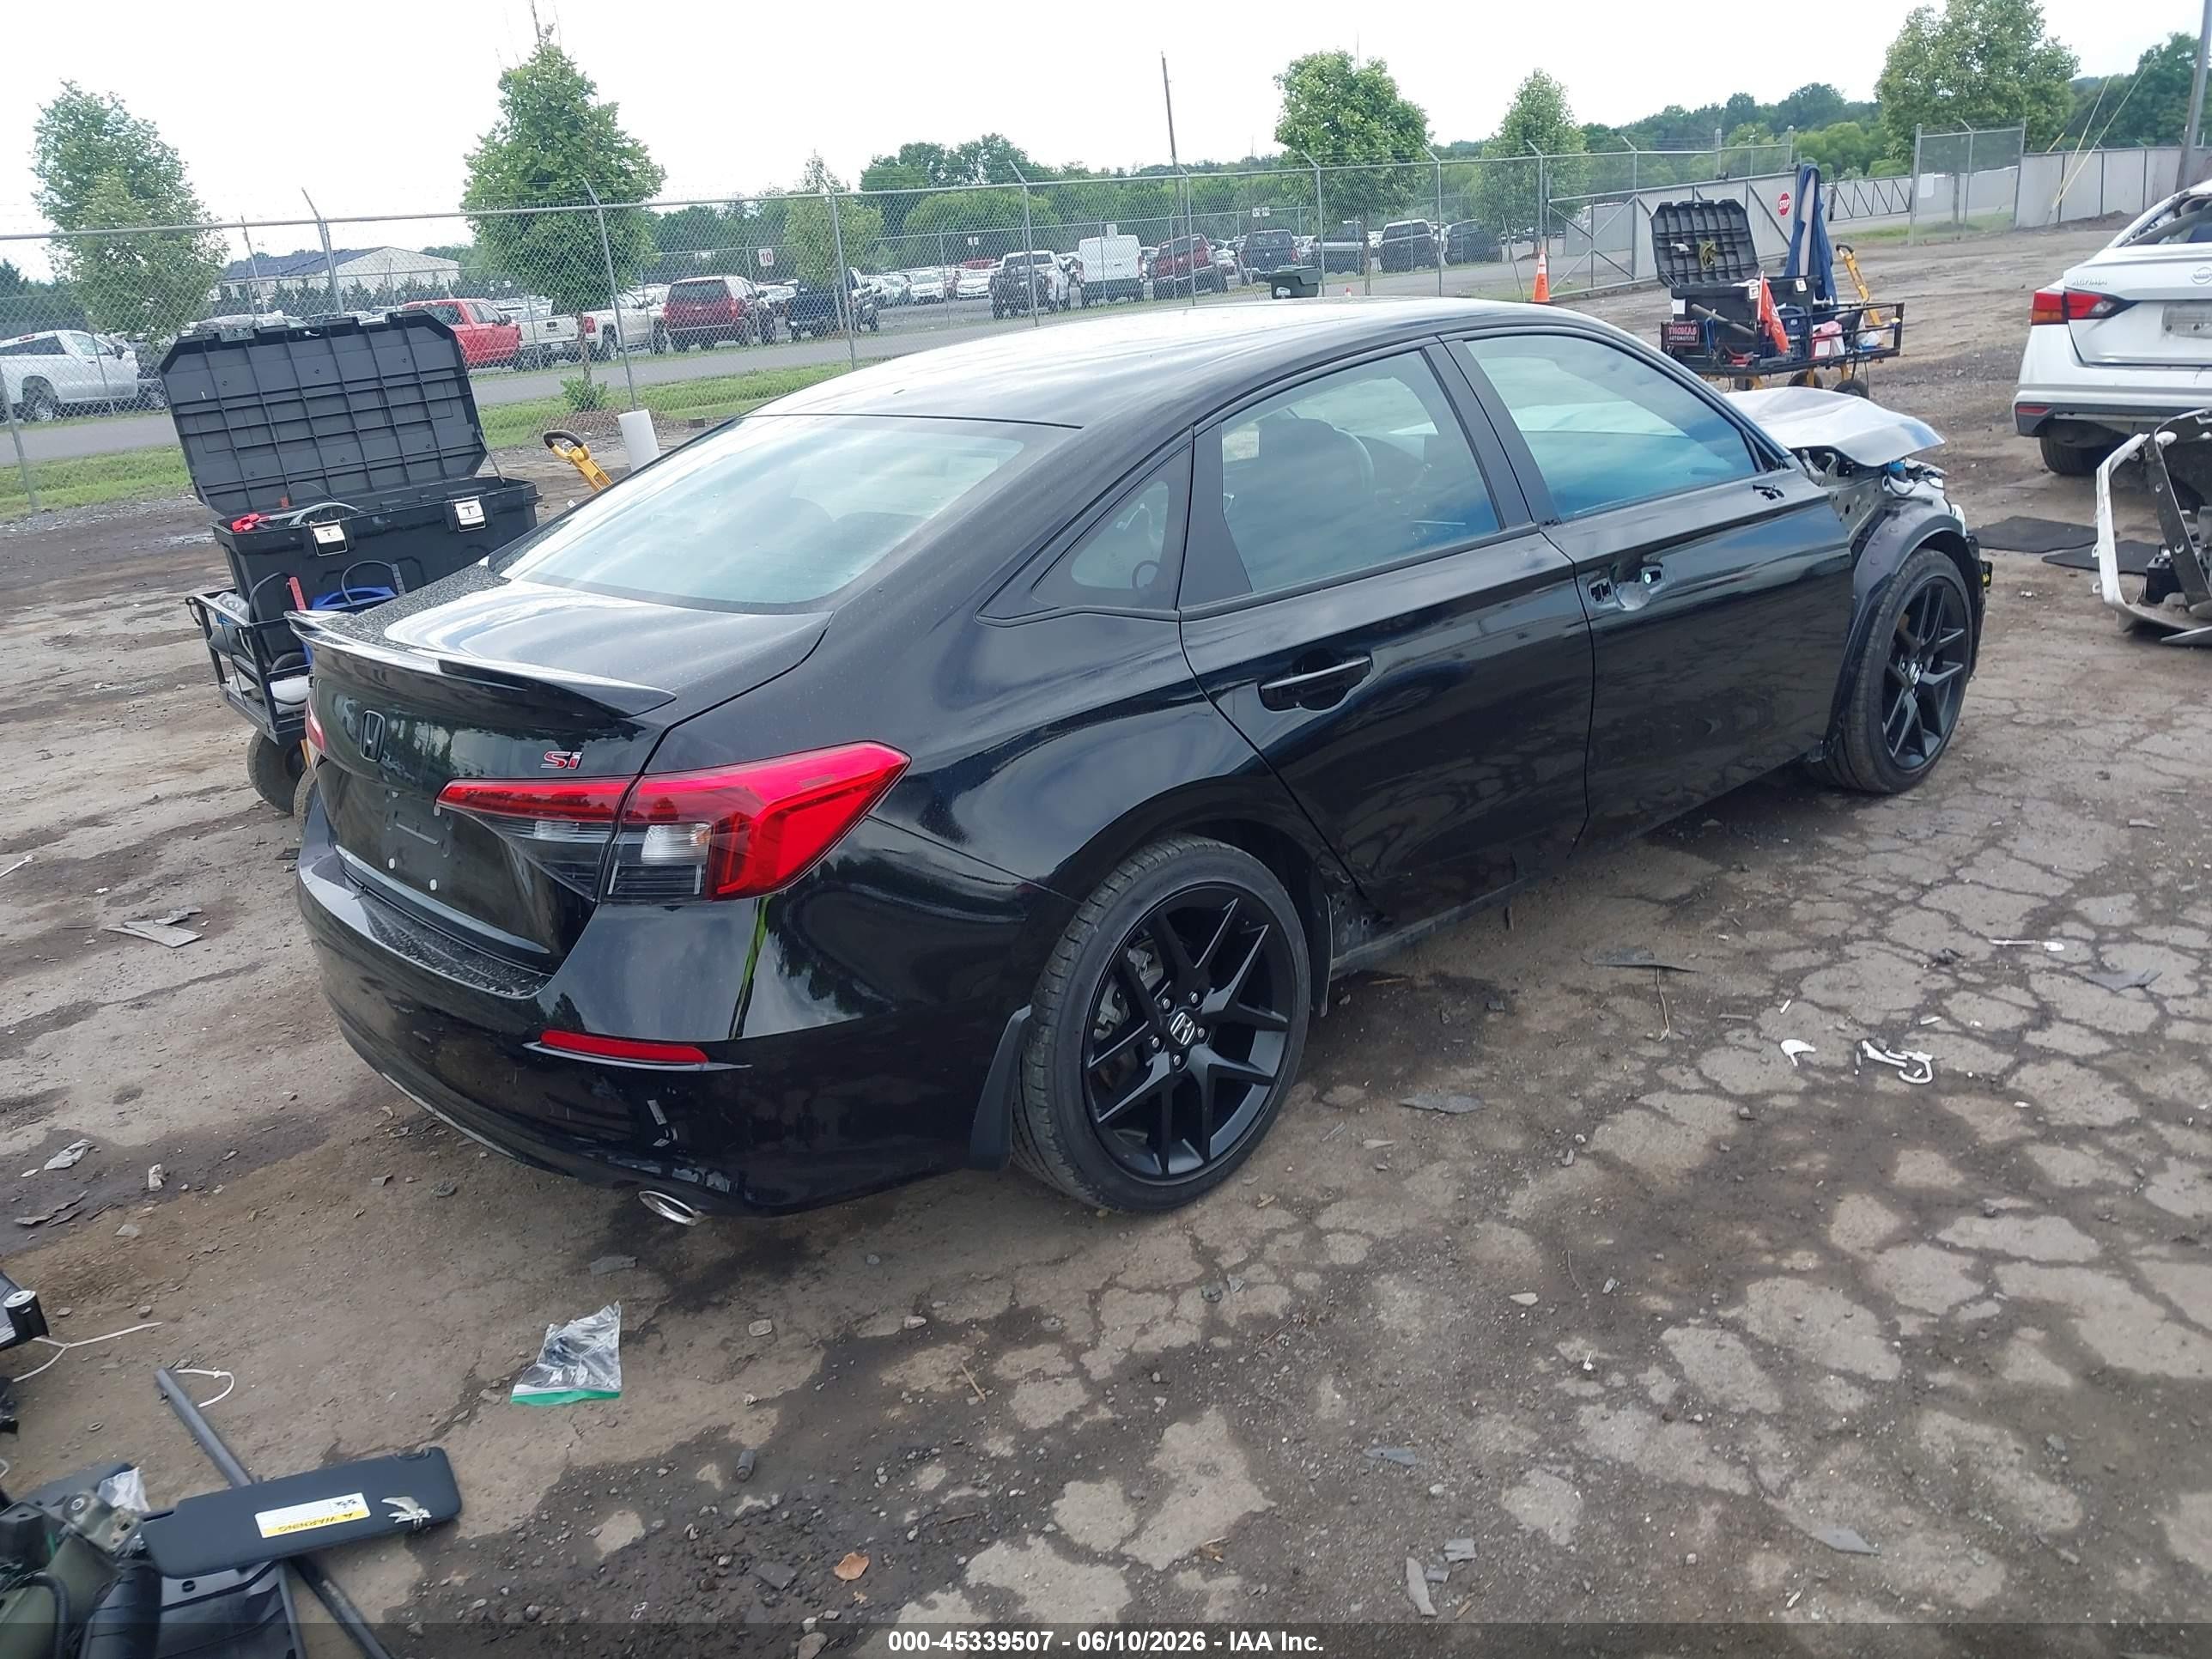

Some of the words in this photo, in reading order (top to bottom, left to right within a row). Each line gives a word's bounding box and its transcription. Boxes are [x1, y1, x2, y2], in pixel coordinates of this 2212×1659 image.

[1778, 198, 1790, 210] STOP
[760, 252, 772, 263] 10
[1668, 325, 1698, 336] THOMAS
[540, 750, 583, 769] Si
[277, 1516, 336, 1532] WARNING
